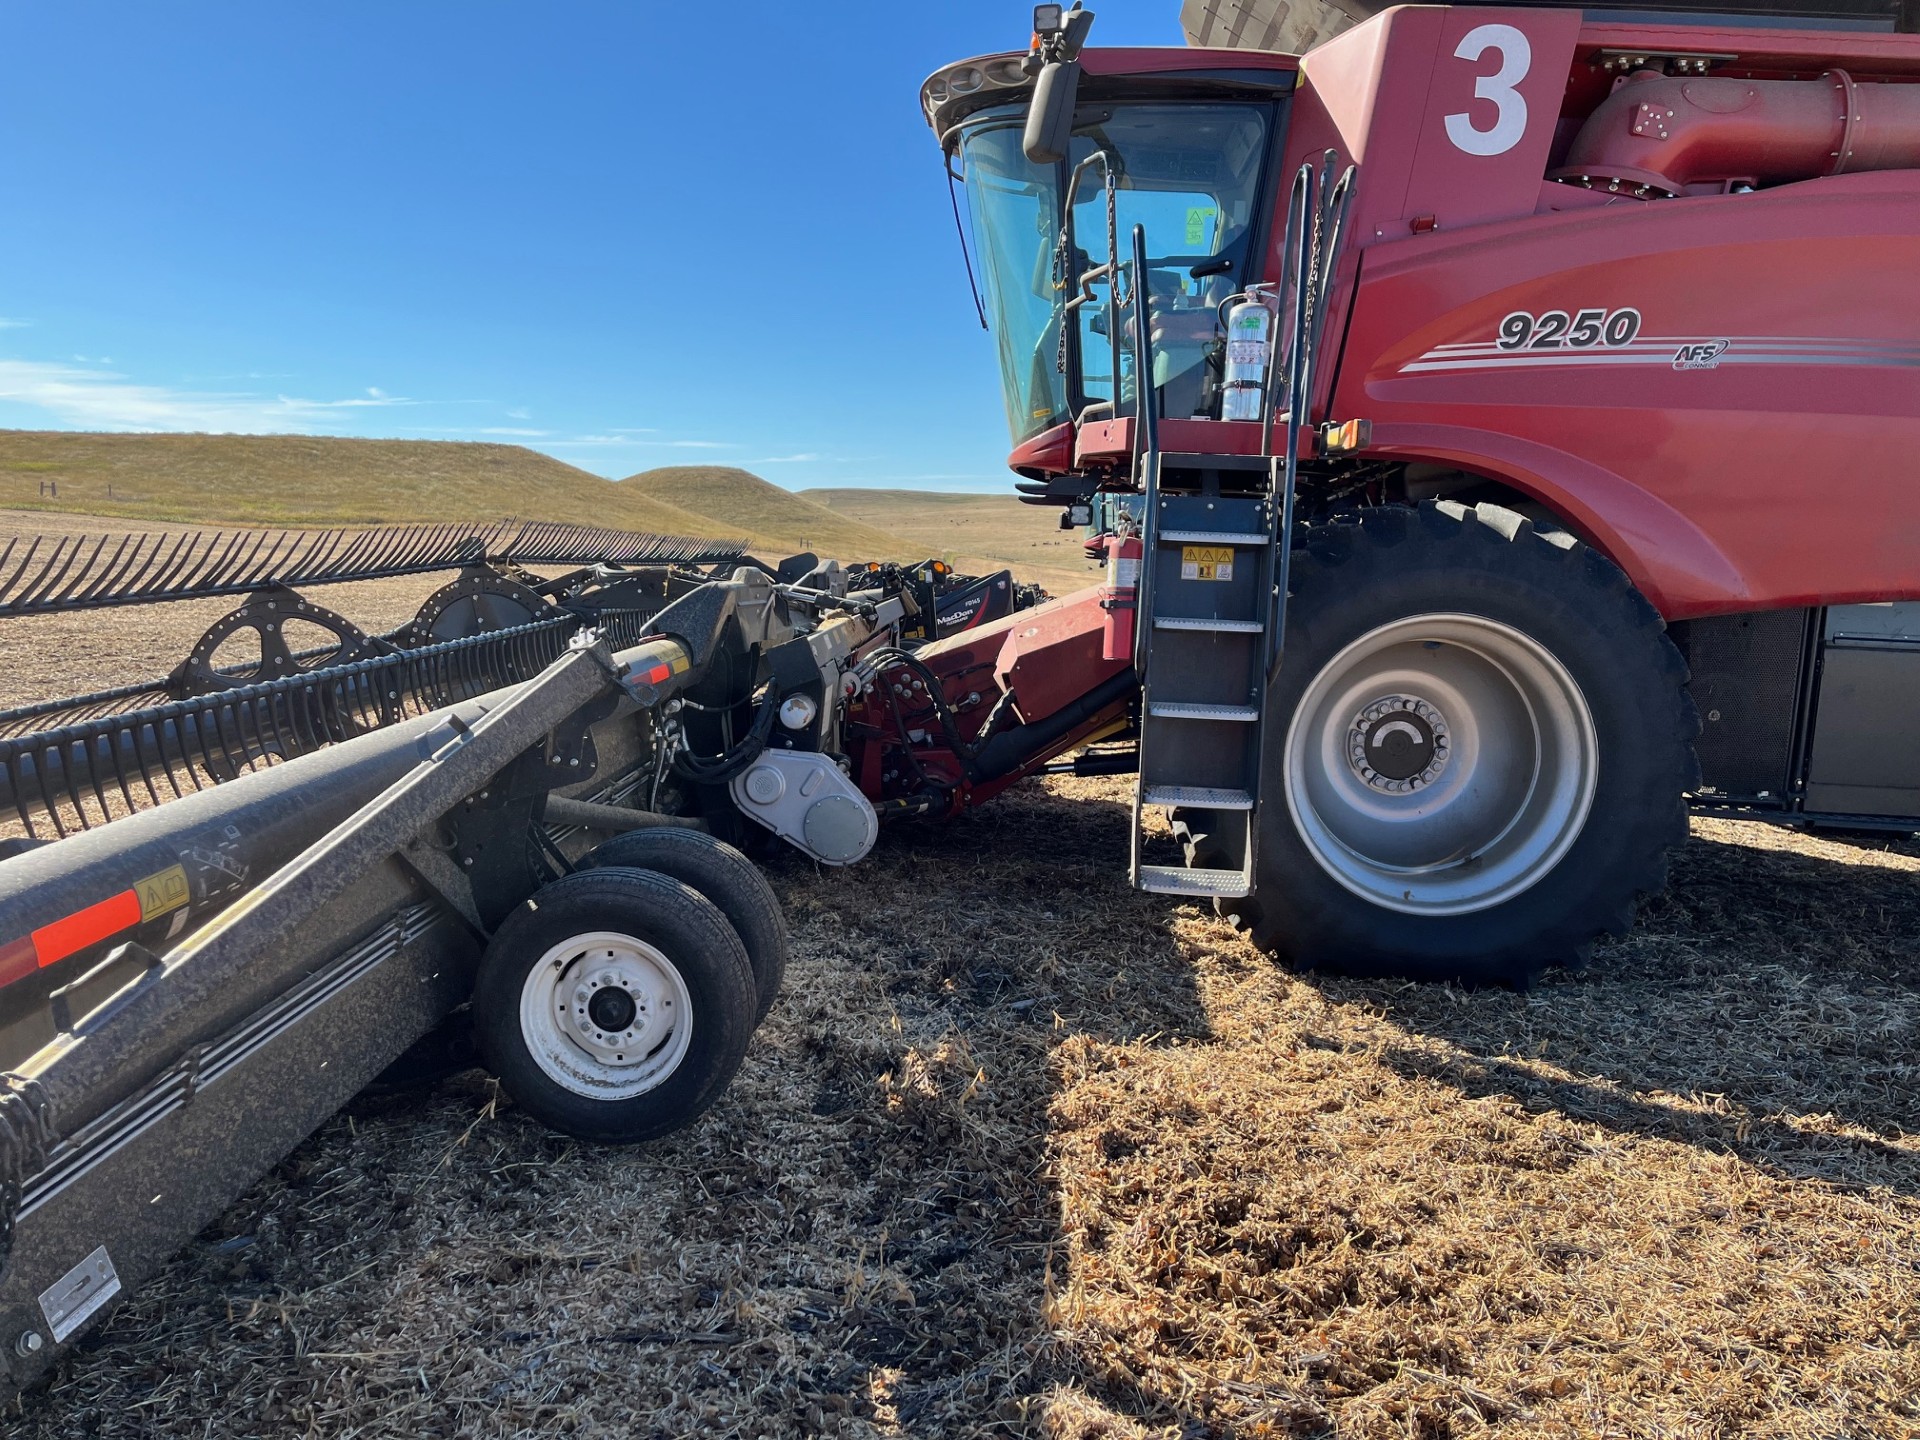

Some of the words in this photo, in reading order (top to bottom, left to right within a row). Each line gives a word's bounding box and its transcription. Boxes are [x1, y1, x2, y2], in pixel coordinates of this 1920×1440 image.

[1444, 23, 1531, 156] 3
[1496, 307, 1641, 350] 9250
[1673, 344, 1718, 362] AFS
[937, 609, 974, 625] MacDon
